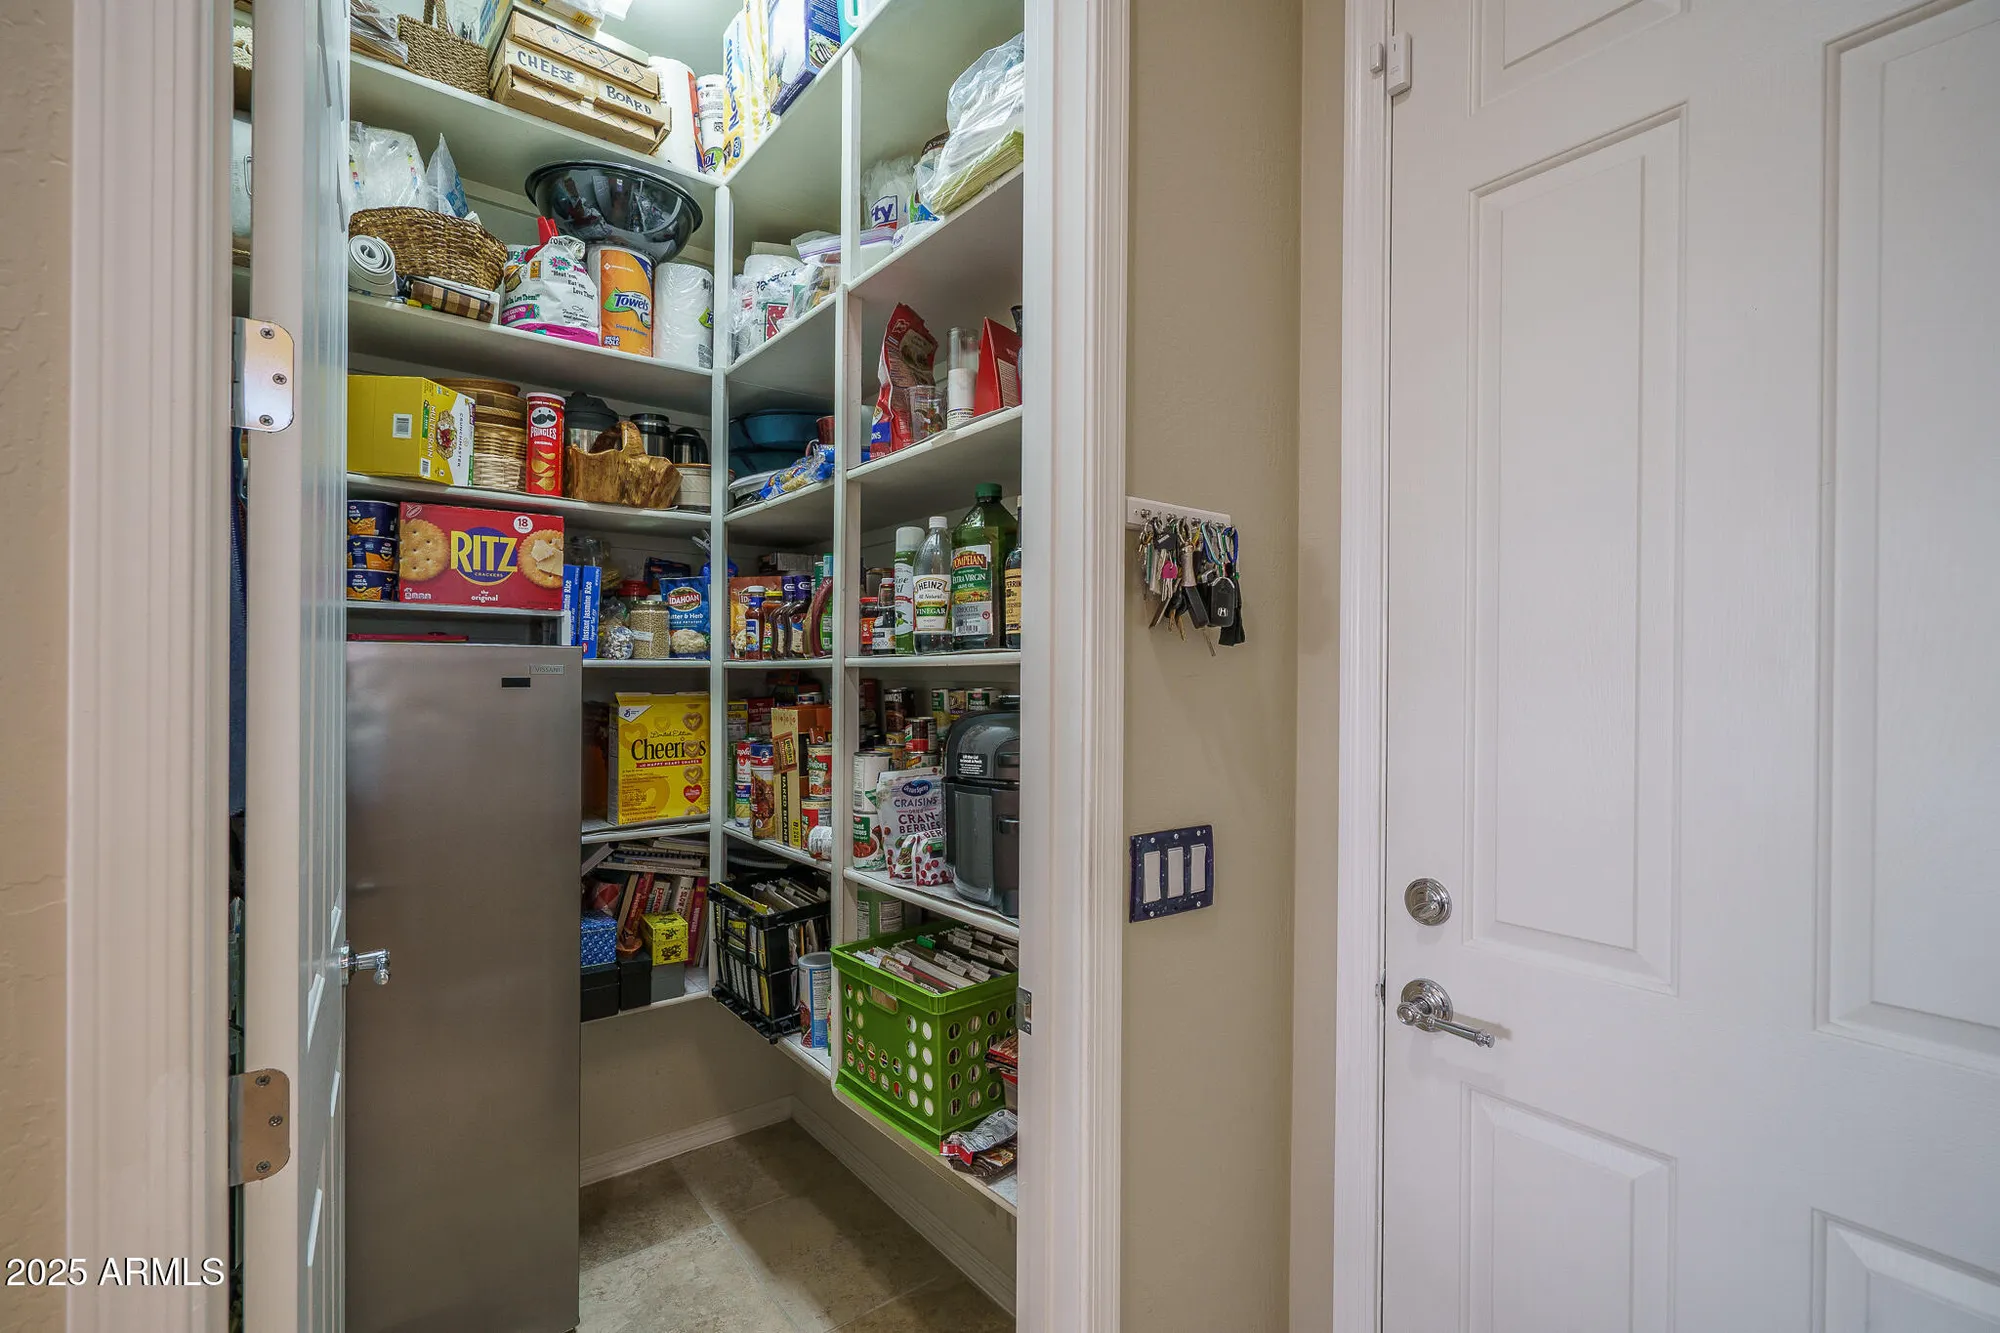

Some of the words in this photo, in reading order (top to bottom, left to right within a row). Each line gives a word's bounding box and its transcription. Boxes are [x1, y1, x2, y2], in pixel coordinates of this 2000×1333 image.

[517, 50, 576, 84] CHEESE
[605, 85, 652, 115] BOARD
[614, 293, 649, 311] Towels
[530, 426, 557, 440] PRINGLES
[517, 519, 528, 527] 18
[451, 531, 518, 573] RITZ
[965, 573, 986, 582] VIRGIN
[584, 581, 592, 594] Rice
[918, 580, 943, 592] HEINZ
[471, 594, 498, 603] original
[668, 594, 700, 605] IDAHOAN
[584, 595, 592, 619] Jasmine
[916, 607, 946, 615] VINEGAR
[582, 619, 590, 641] Instant
[631, 738, 706, 761] Cheerios
[916, 784, 929, 793] Spray
[894, 797, 938, 808] CRAISINS
[899, 812, 939, 824] CRAN-
[900, 821, 941, 834] BERRIES
